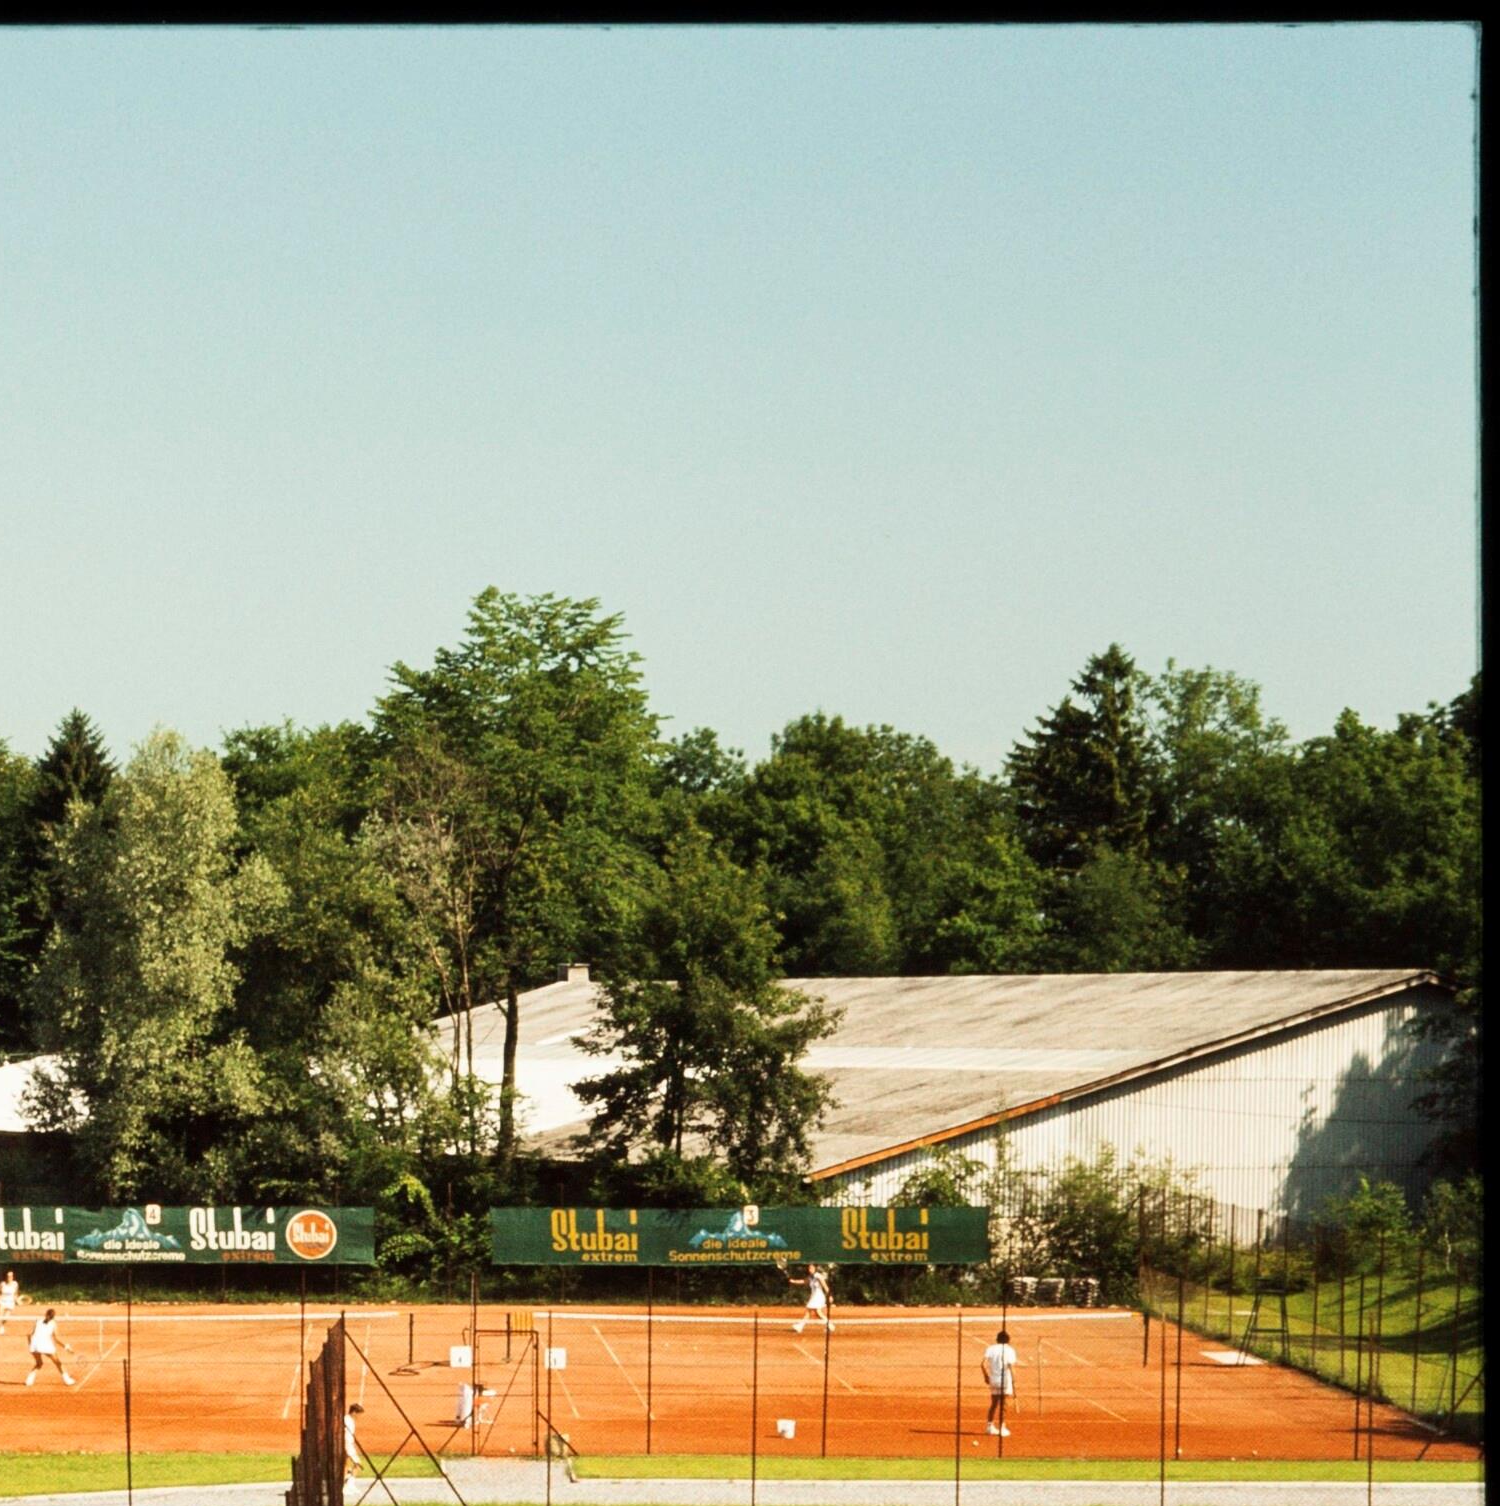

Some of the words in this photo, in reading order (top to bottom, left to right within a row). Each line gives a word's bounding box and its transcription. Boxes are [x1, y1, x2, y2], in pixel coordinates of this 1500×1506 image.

[189, 1207, 275, 1250] Stubai
[292, 1222, 330, 1243] Stubai
[551, 1209, 638, 1251] Stubai
[841, 1208, 929, 1250] Stubai
[103, 1239, 122, 1250] die
[124, 1239, 160, 1250] ideale
[702, 1239, 722, 1249] die
[728, 1238, 767, 1249] ideale
[76, 1249, 186, 1261] Sonnenschutzcreme
[582, 1252, 638, 1262] extrem
[668, 1250, 800, 1262] Sonnenschutzcreme
[870, 1252, 928, 1262] extrem
